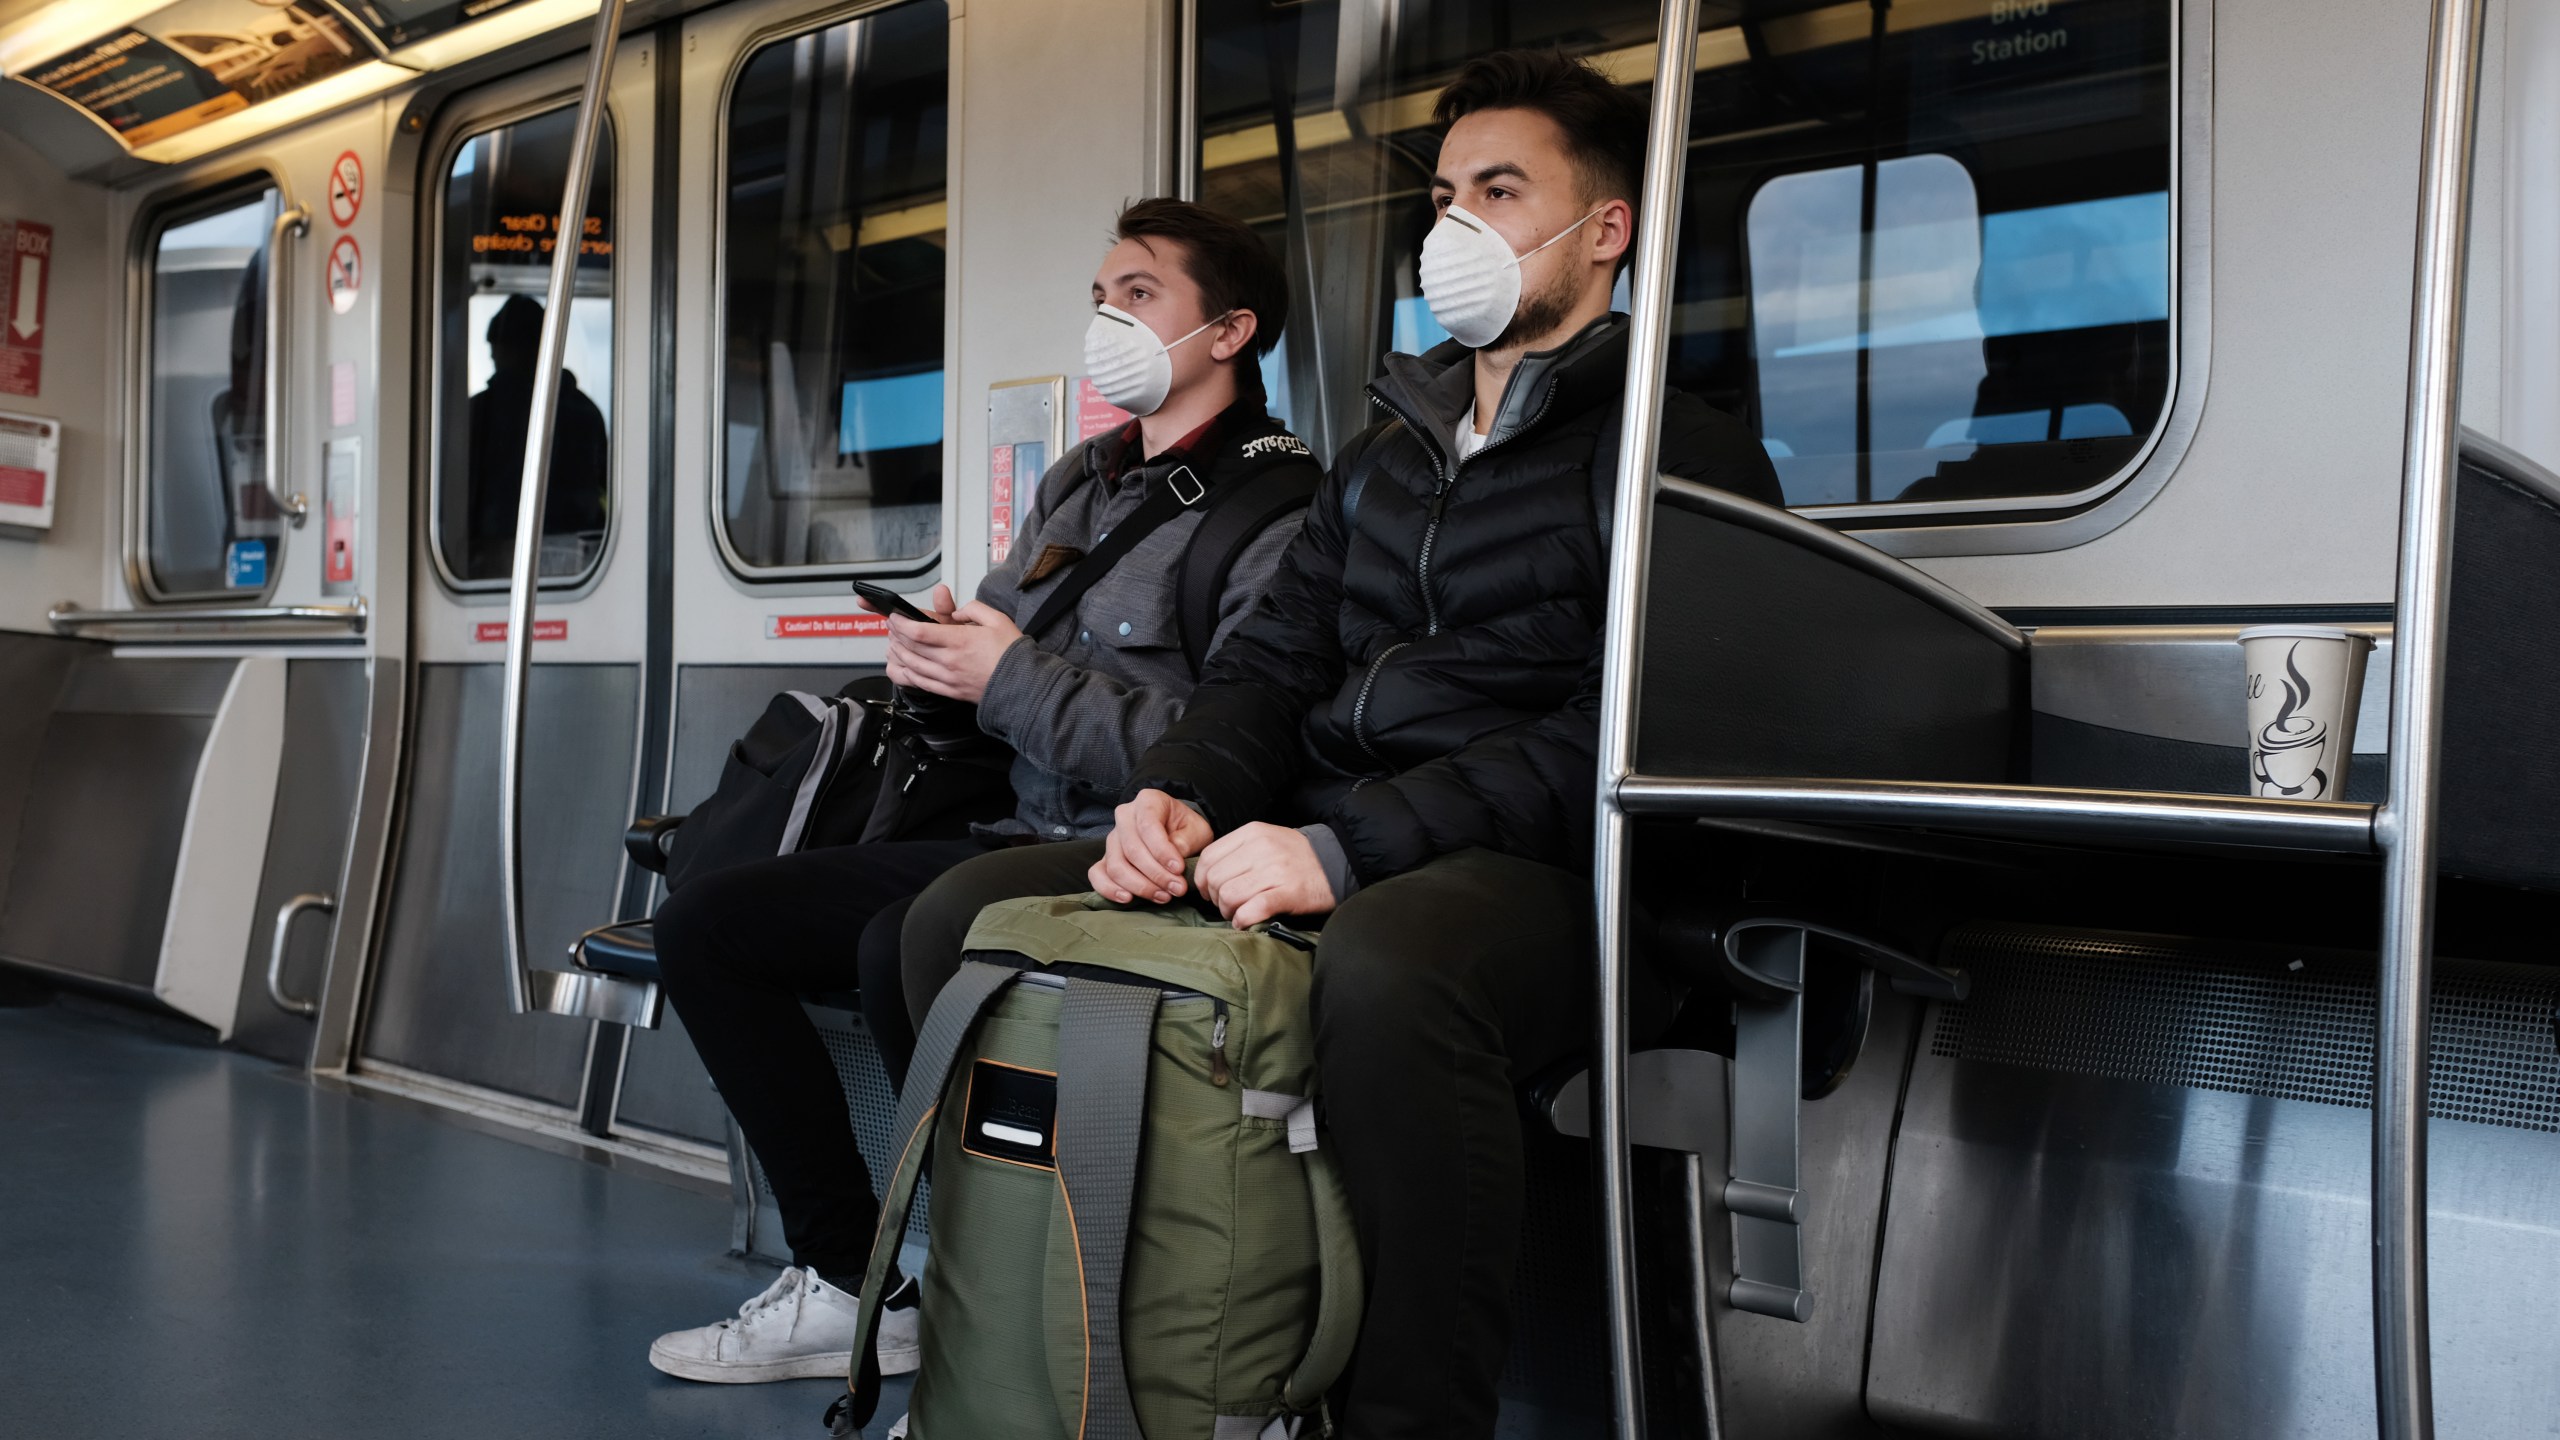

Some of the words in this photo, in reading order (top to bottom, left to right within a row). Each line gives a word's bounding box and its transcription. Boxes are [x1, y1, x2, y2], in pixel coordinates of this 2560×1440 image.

[1972, 29, 2067, 65] Station
[16, 229, 49, 256] BOX
[1241, 435, 1310, 458] Titleist
[813, 621, 823, 631] Do
[823, 621, 836, 631] Not
[836, 621, 853, 631] Lean
[853, 620, 879, 633] Against
